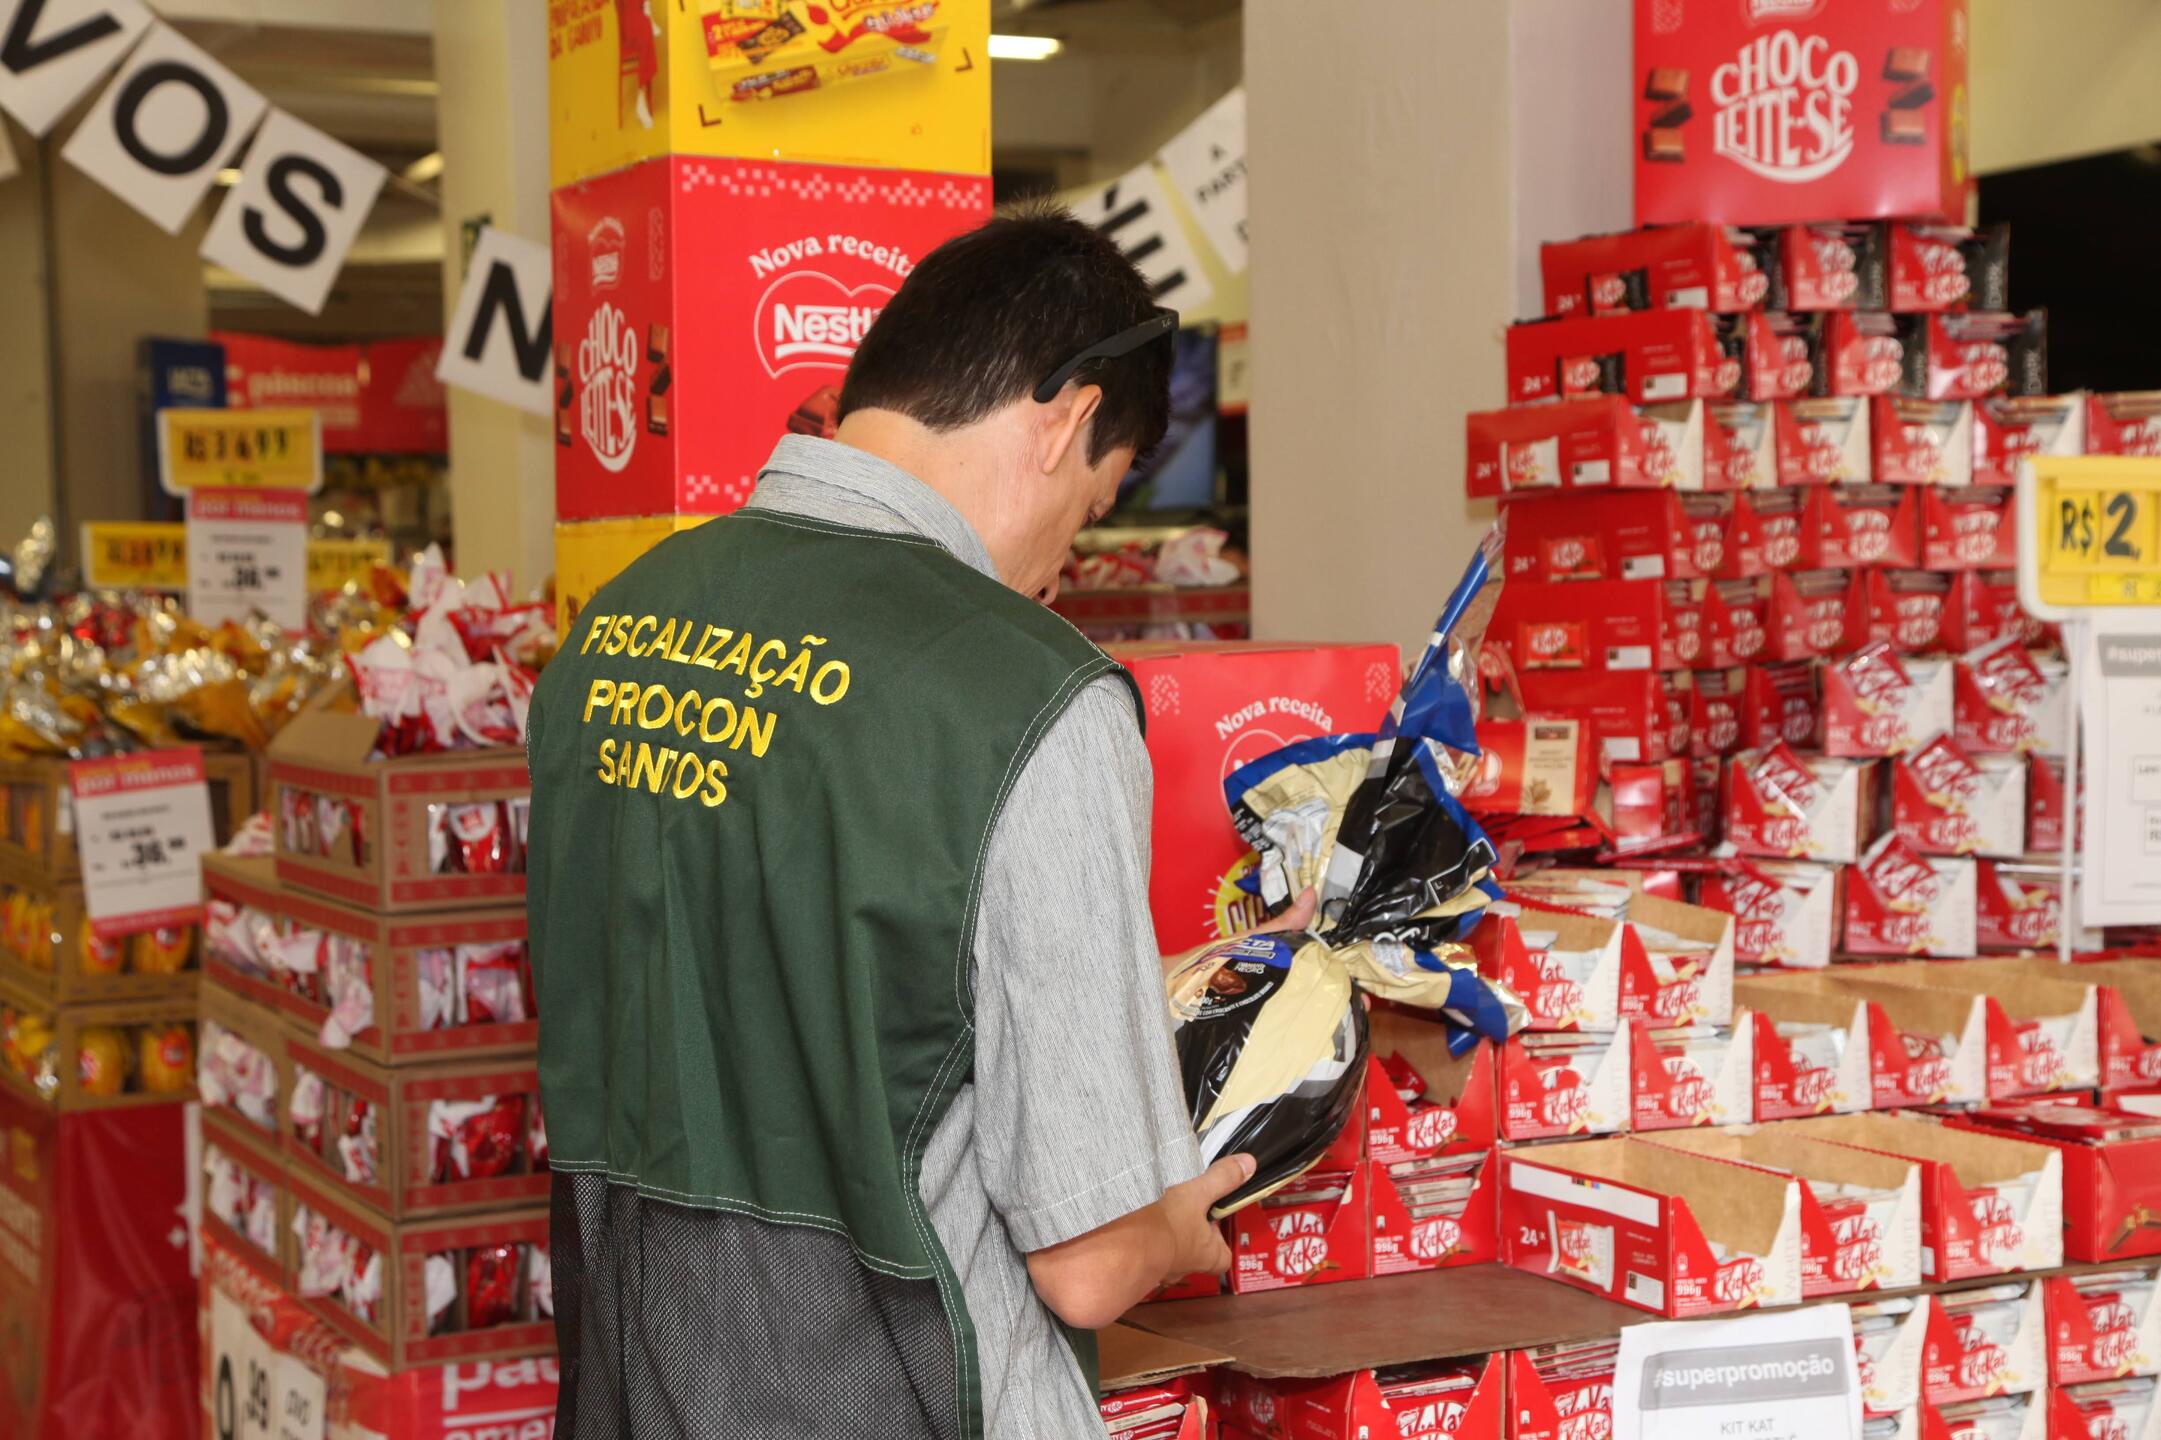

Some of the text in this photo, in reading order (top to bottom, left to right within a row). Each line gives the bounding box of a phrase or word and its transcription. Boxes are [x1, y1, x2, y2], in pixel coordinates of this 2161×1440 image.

[1711, 29, 1858, 105] CHOCO
[1713, 88, 1853, 167] LEITE-SE
[749, 234, 822, 280] Nova
[578, 301, 638, 384] CHOCO
[774, 304, 884, 343] Nestl
[2061, 499, 2095, 557] R$
[580, 614, 851, 706] FISCALIZAÇÃO
[583, 679, 778, 759] PROCON
[1215, 697, 1335, 740] Nova receita
[598, 738, 729, 808] SANTOS
[1537, 983, 1585, 1019] KitKat
[1655, 980, 1701, 1019] KitKat
[1670, 1079, 1716, 1118] KitKat
[1793, 1072, 1838, 1106] KitKat
[1906, 1061, 1951, 1097] KitKat
[1543, 1088, 1590, 1126] KitKat
[1368, 1132, 1396, 1145] 996g
[1406, 1110, 1459, 1149] KitKat
[1275, 1235, 1329, 1277] KitKat
[1374, 1241, 1399, 1253] 996g
[1410, 1218, 1462, 1260] KitKat
[1519, 1226, 1538, 1247] 24
[1239, 1257, 1264, 1271] 996g
[1834, 1241, 1884, 1280] KitKat
[1675, 1284, 1702, 1297] 996g
[1714, 1262, 1765, 1303] KitKat
[1960, 1349, 2009, 1387] KitKat
[2092, 1330, 2140, 1369] KitKat
[1654, 1354, 1835, 1389] #superpromoção
[1720, 1417, 1775, 1434] KIT KAT
